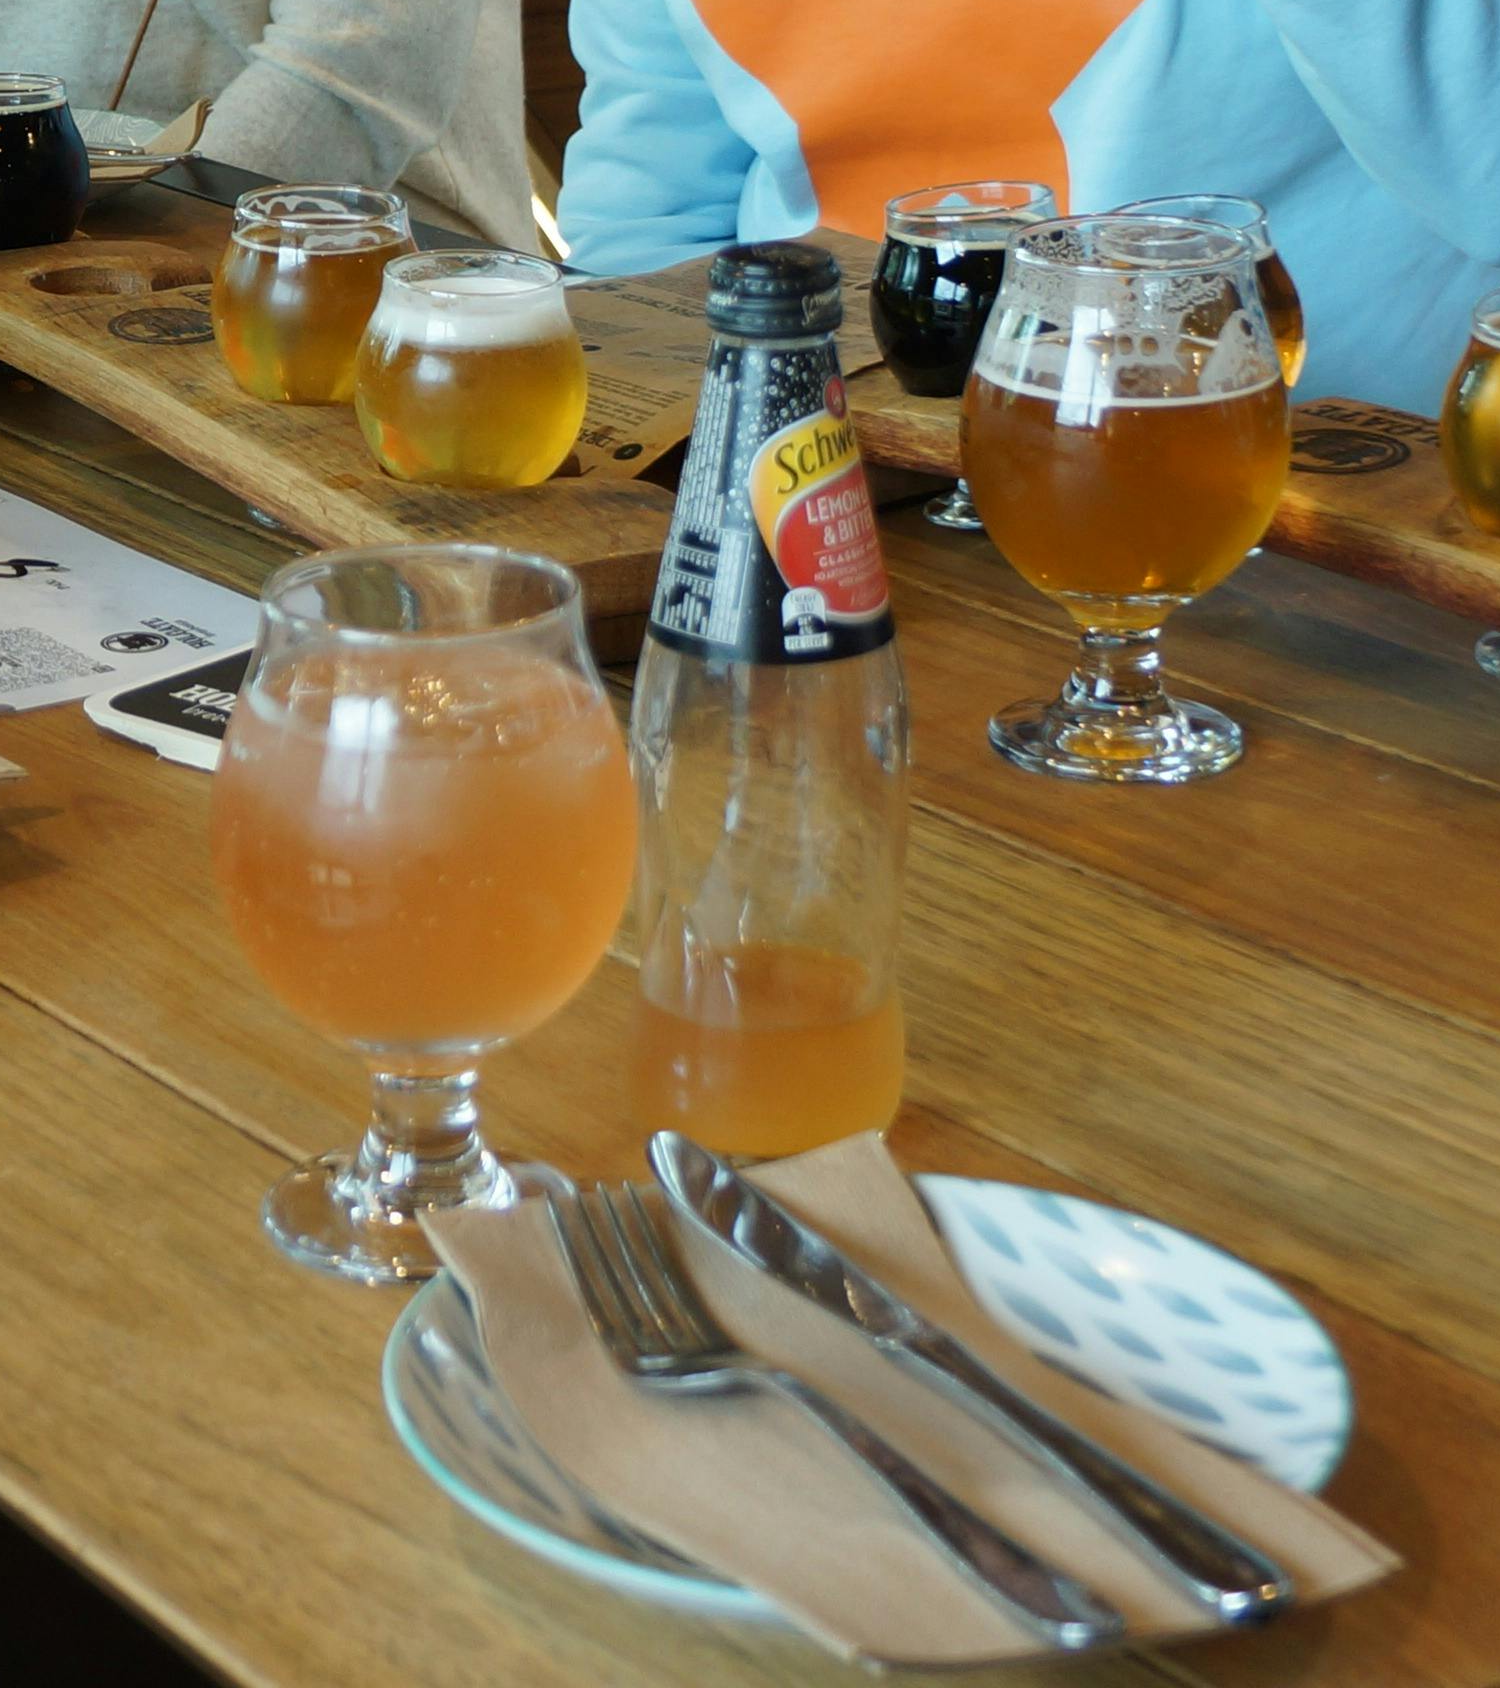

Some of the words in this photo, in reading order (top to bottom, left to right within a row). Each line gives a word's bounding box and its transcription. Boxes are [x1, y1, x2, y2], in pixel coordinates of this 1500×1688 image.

[805, 490, 861, 525] LEMON
[823, 524, 837, 547] &
[140, 617, 216, 650] HOLGATE
